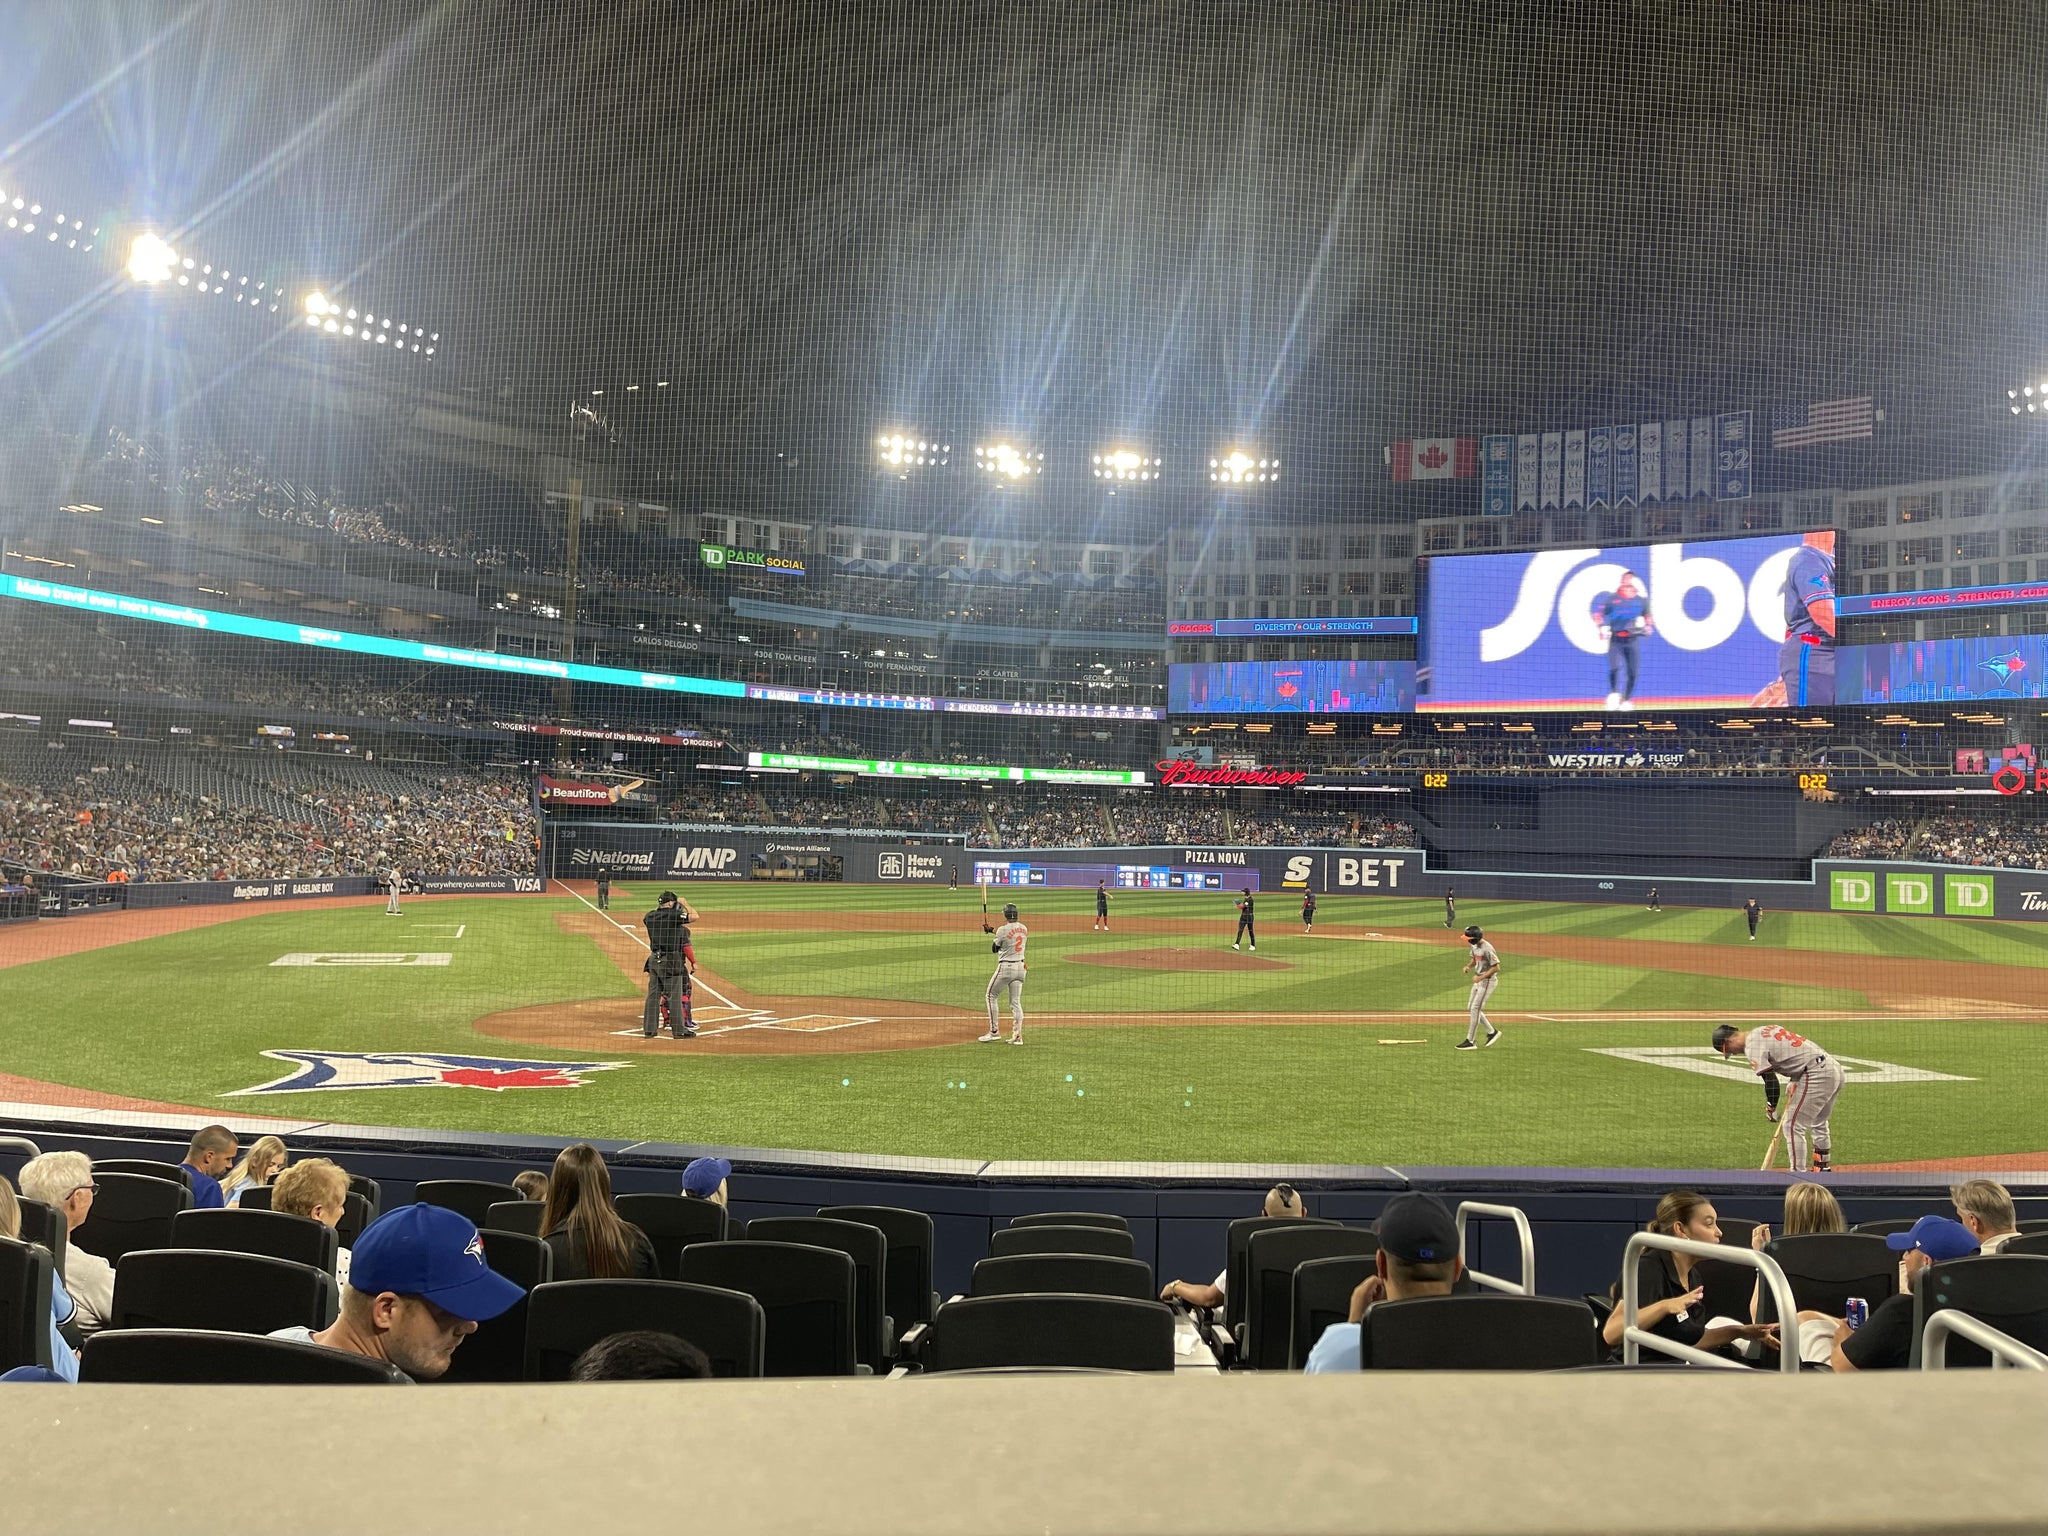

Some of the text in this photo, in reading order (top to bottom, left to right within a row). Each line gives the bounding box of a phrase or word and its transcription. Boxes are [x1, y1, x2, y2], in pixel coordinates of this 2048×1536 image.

[1719, 448, 1750, 471] 32
[703, 548, 806, 570] TD PARK SOCIAL
[1179, 623, 1214, 633] ROGERS
[1254, 621, 1374, 632] DIVERSITY OUR STRENGTH
[633, 635, 698, 650] CARLOS DELGADO
[754, 650, 817, 663] 4306 TOM CHEEK
[864, 660, 927, 672] TONY FERNANDEZ
[976, 668, 1019, 678] JOE CARTER
[1082, 674, 1130, 683] GEORGE BELL
[958, 703, 998, 713] HENDERSON
[501, 723, 527, 732] ROGERS
[559, 727, 661, 744] Proud owner of the Blue Jays
[689, 739, 713, 748] ROGERS
[1648, 753, 1685, 763] FLIGHT
[1155, 759, 1307, 785] Budweiser
[1424, 774, 1448, 788] 0:22
[1799, 774, 1827, 789] 0:22
[553, 787, 607, 799] BeautiTone
[560, 831, 576, 839] 328
[776, 844, 805, 853] Pathways
[673, 847, 737, 869] MNP
[907, 854, 942, 867] Here's
[1185, 851, 1246, 865] PIZZA NOVA
[625, 864, 650, 872] Rental
[693, 870, 717, 878] Business
[907, 866, 936, 879] How.
[1338, 858, 1405, 888] BET
[233, 883, 287, 898] theScore BET
[292, 882, 334, 895] BASELINE BOX
[425, 880, 462, 890] everywhere
[462, 882, 475, 890] you
[475, 881, 490, 889] want
[497, 880, 506, 888] be
[512, 878, 542, 892] VISA
[1598, 881, 1614, 890] 400
[1835, 878, 1871, 903] TD
[1891, 880, 1929, 905] TD
[1950, 881, 1989, 907] TD
[1014, 936, 1023, 953] 2
